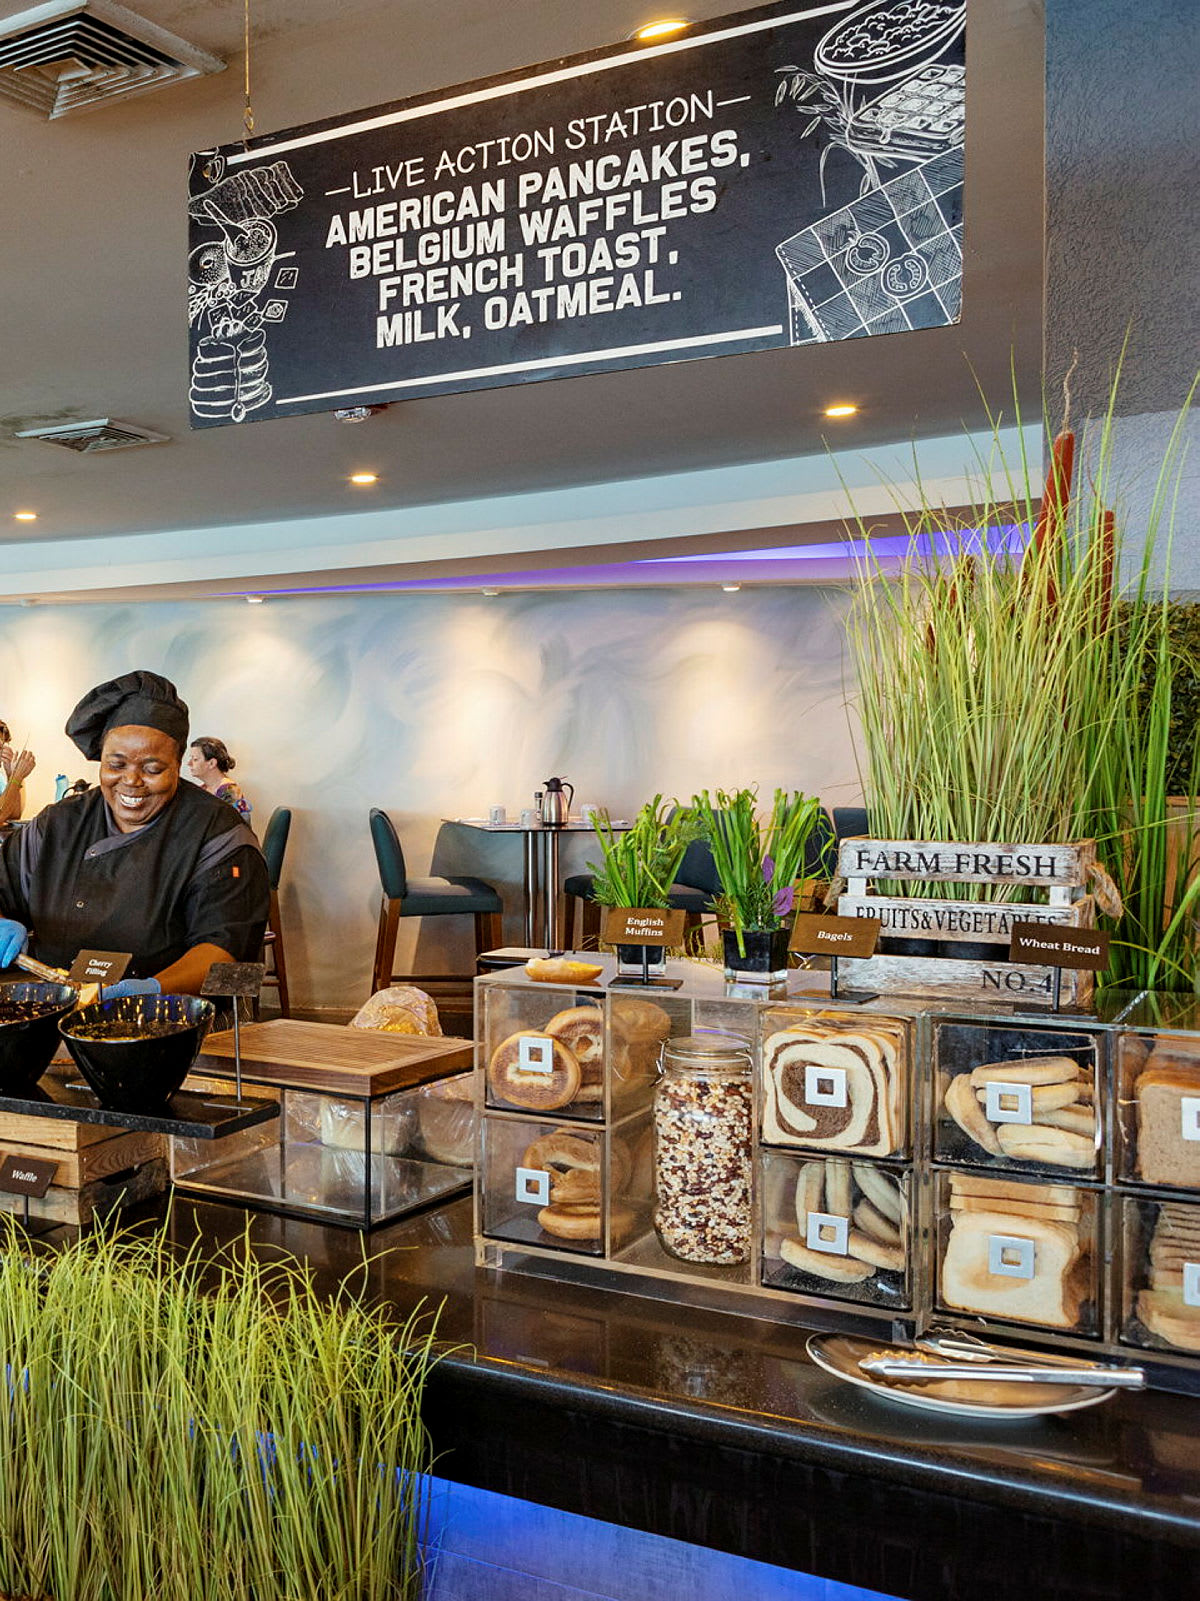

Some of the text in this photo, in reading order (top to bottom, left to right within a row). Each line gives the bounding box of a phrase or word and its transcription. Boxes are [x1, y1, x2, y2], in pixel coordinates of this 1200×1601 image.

[353, 89, 713, 199] LIVE ACTION STATION
[325, 129, 750, 249] AMERICAN PANCAKES,
[350, 176, 717, 280] BELGIUM WAFFLES
[379, 226, 679, 312] FRENCH TOAST,
[376, 270, 682, 349] MILK, OATMEAL.
[856, 850, 1058, 878] FARM FRESH
[626, 917, 664, 928] English
[625, 927, 664, 937] Muffins
[817, 930, 853, 942] Bagels
[1019, 937, 1100, 955] Wheat Bread
[84, 967, 108, 977] Filling
[88, 958, 113, 969] Cherry
[11, 1169, 38, 1183] Waffle
